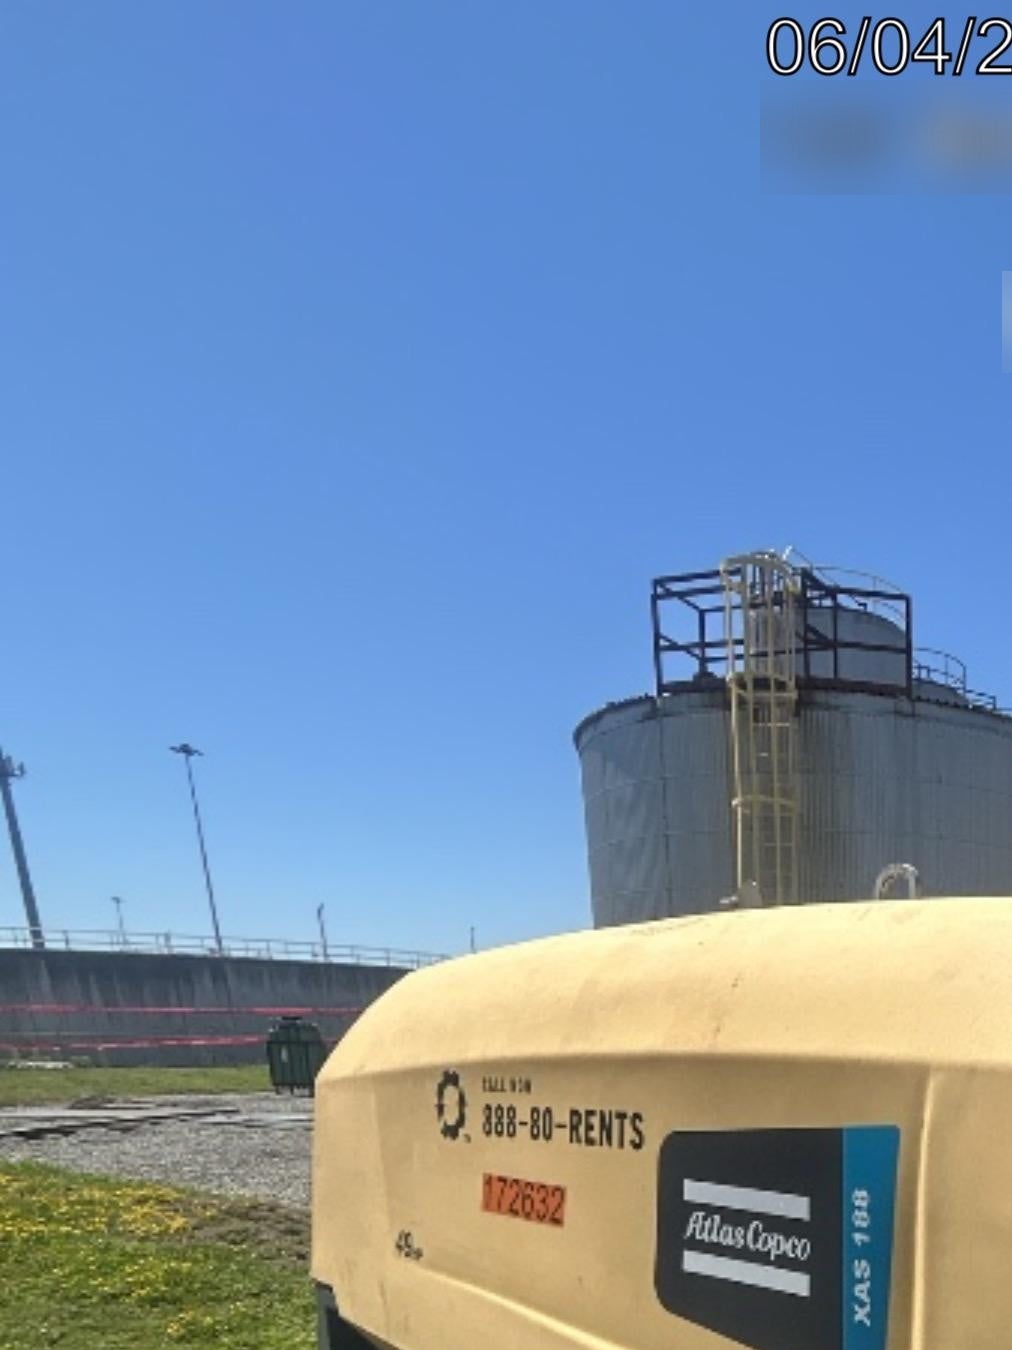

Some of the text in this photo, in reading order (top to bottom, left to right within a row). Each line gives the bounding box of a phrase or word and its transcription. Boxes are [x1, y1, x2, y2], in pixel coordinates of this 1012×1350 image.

[482, 1103, 645, 1151] 888-80-RENTS
[484, 1173, 564, 1227] 172632
[684, 1211, 811, 1261] Atlas Copco
[852, 1187, 871, 1328] XAS 188
